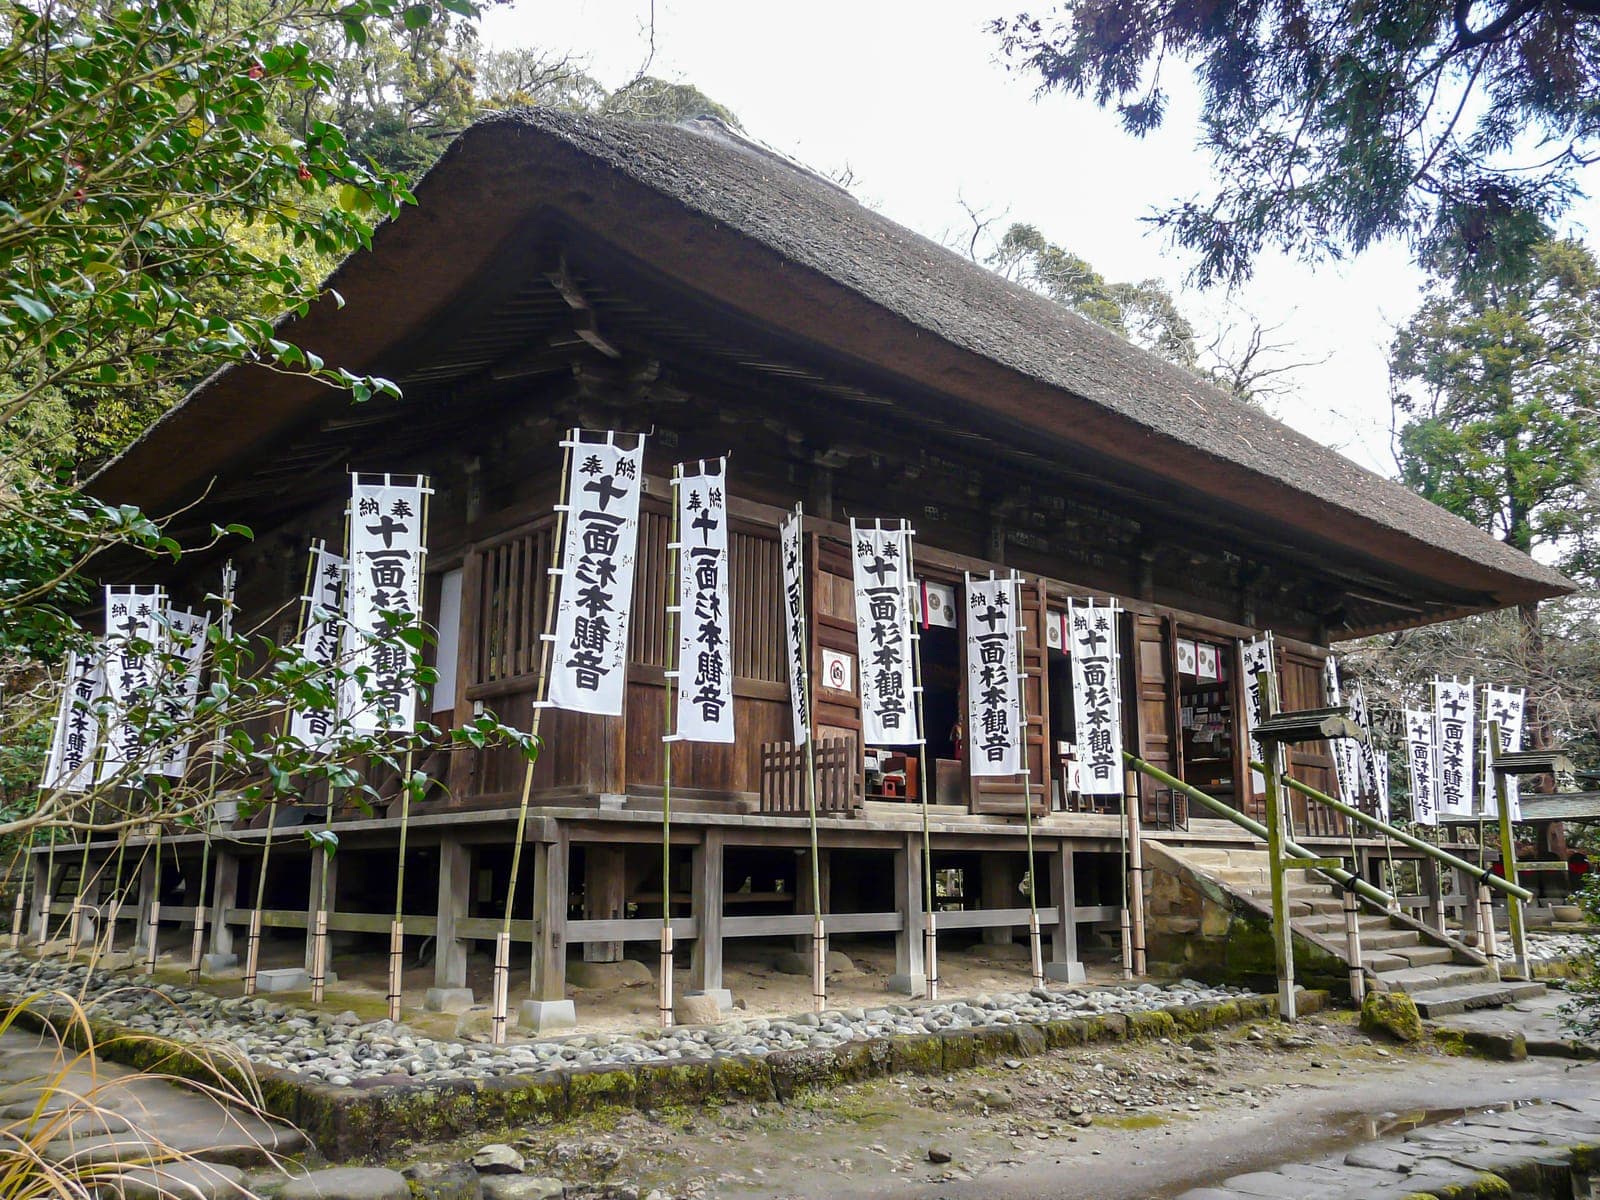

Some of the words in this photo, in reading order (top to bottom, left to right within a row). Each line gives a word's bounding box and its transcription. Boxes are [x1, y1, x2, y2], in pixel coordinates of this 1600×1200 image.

[863, 555, 906, 729] 十一面杉本観音
[975, 605, 1011, 762] 十一面杉本観音
[1079, 629, 1116, 780] 十一面杉本観音
